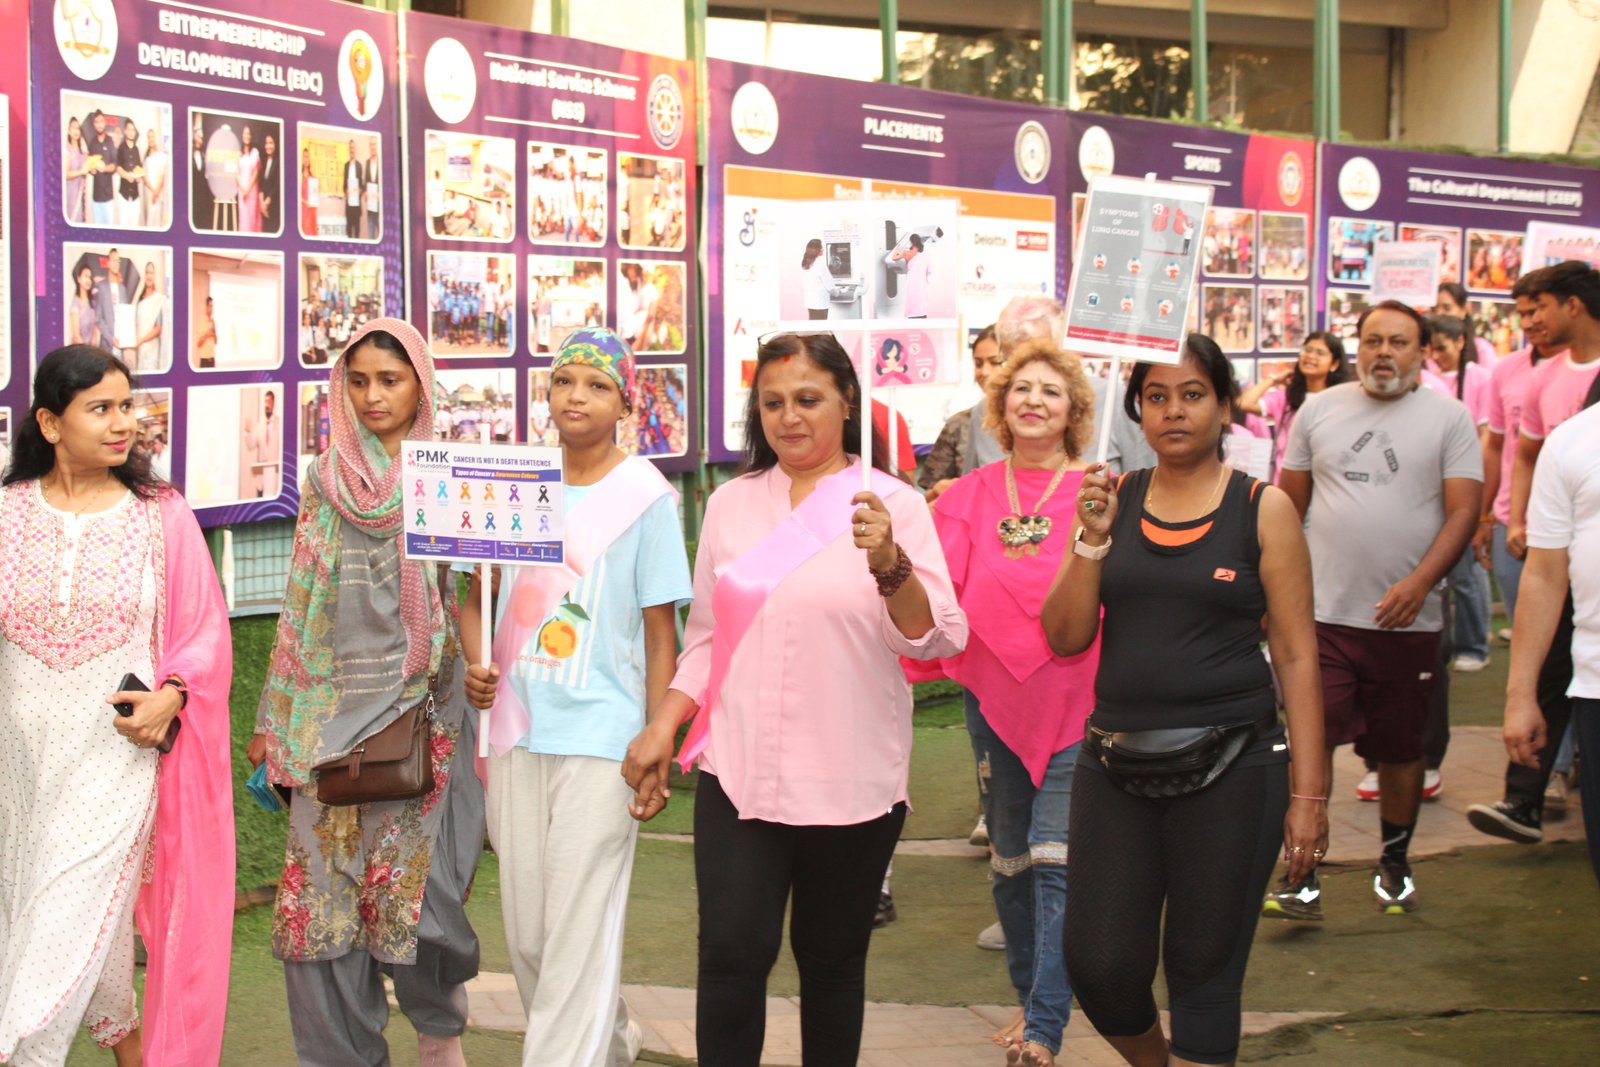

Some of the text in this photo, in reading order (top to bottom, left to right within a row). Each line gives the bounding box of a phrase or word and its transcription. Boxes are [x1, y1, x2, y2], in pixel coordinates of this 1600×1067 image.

[158, 9, 307, 56] ENTREPRENEURSHIP
[138, 42, 323, 97] DEVELOPMENT CELL (EDC)
[490, 61, 636, 101] National Service Scheme
[864, 117, 944, 143] PLACEMENTS
[1184, 155, 1221, 173] SPORTS
[1408, 177, 1431, 193] The
[1431, 179, 1478, 198] Cultural
[1478, 183, 1546, 203] Department
[1099, 208, 1139, 219] SYMPTOMS
[1091, 226, 1140, 238] LUNG CANCER
[416, 449, 449, 463] PMK
[453, 455, 475, 464] CANCER
[483, 457, 495, 465] NOT
[500, 458, 518, 466] DEATH
